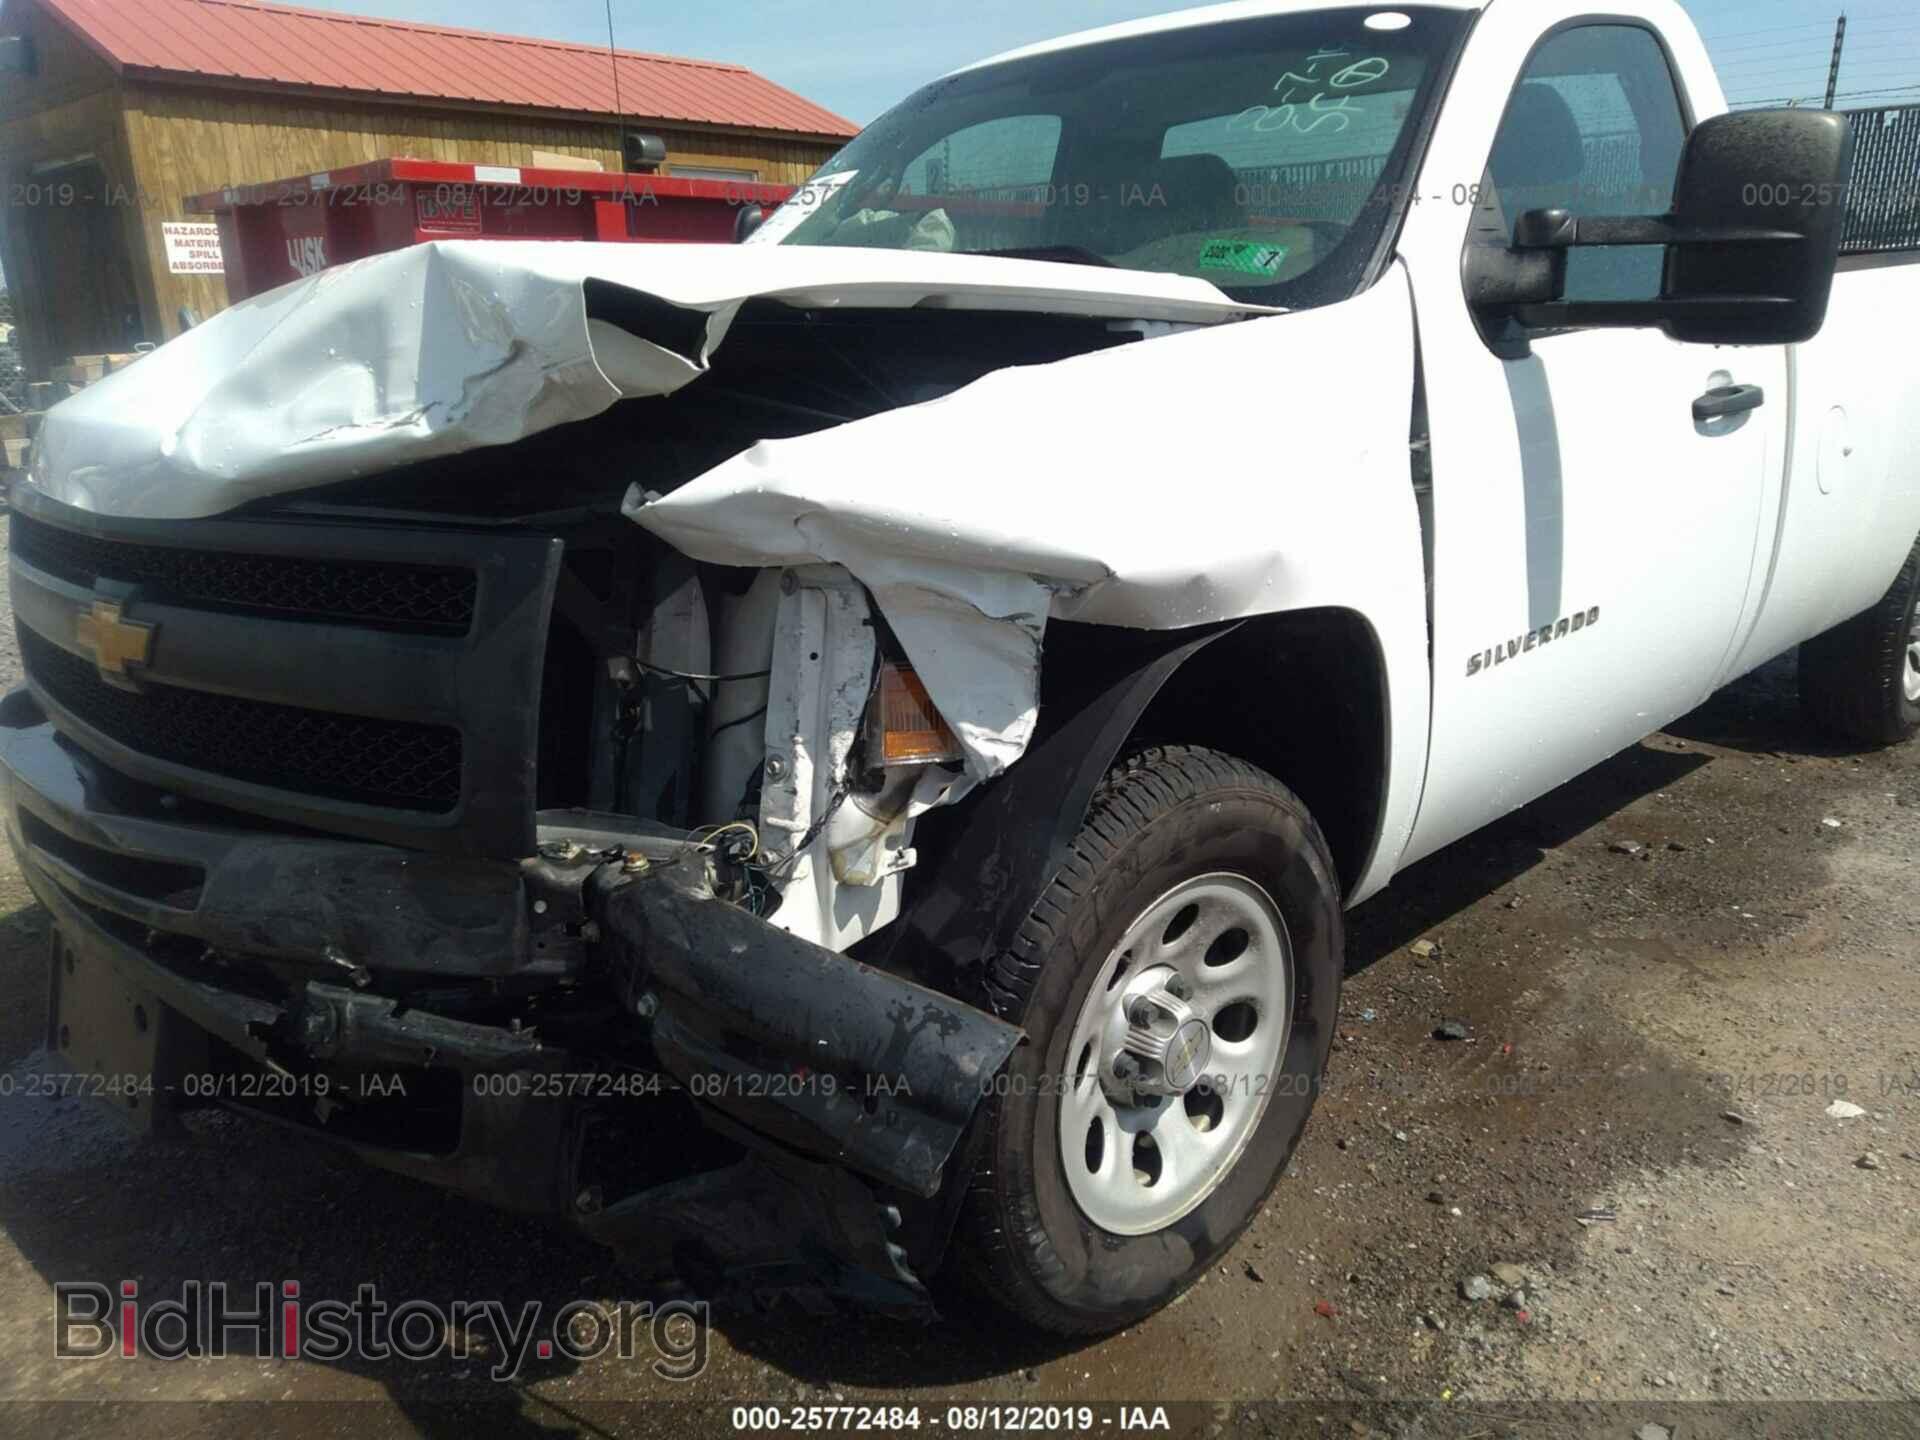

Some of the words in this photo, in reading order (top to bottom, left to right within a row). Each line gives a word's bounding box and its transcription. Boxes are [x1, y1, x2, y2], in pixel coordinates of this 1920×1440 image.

[164, 226, 220, 236] HAZARDO
[175, 239, 222, 248] MATERIA
[189, 250, 219, 259] SPILL
[172, 261, 224, 270] ABSORBE
[1465, 605, 1601, 678] SILVERADO
